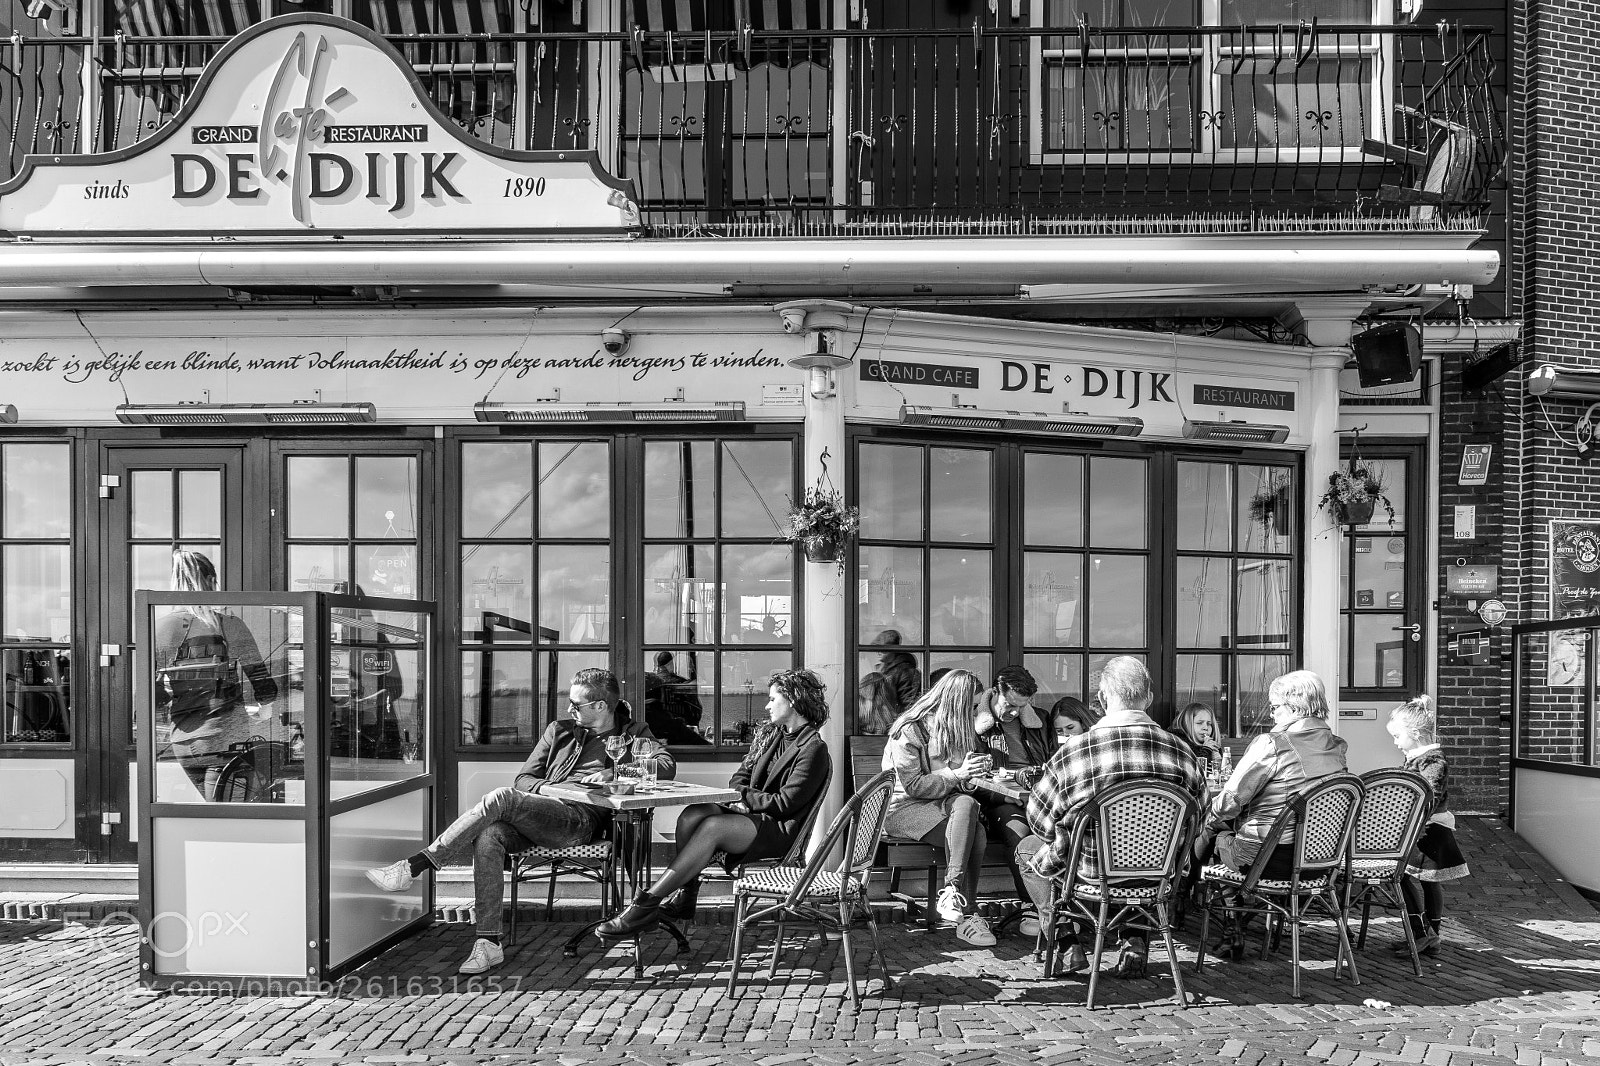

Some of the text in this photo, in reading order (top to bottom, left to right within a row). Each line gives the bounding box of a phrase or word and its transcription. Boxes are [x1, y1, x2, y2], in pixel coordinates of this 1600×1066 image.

[197, 128, 253, 143] GRAND
[330, 127, 423, 143] RESTAURANT
[85, 179, 129, 200] sinds
[170, 152, 465, 213] DE DIJK
[503, 176, 546, 198] 1890
[1, 351, 60, 372] zoekt
[63, 354, 81, 375] is
[64, 351, 140, 384] gelijk
[145, 360, 177, 371] een
[181, 350, 242, 373] blinde,
[246, 354, 306, 370] want
[449, 352, 468, 374] is
[474, 357, 499, 380] op
[500, 350, 542, 379] deze
[544, 349, 604, 369] aarde
[607, 356, 686, 381] nergens
[690, 351, 709, 368] te
[710, 349, 785, 369] vinden.
[868, 362, 973, 386] GRAND CAFE
[999, 360, 1175, 409] DE DIJK
[1202, 387, 1287, 407] RESTAURANT
